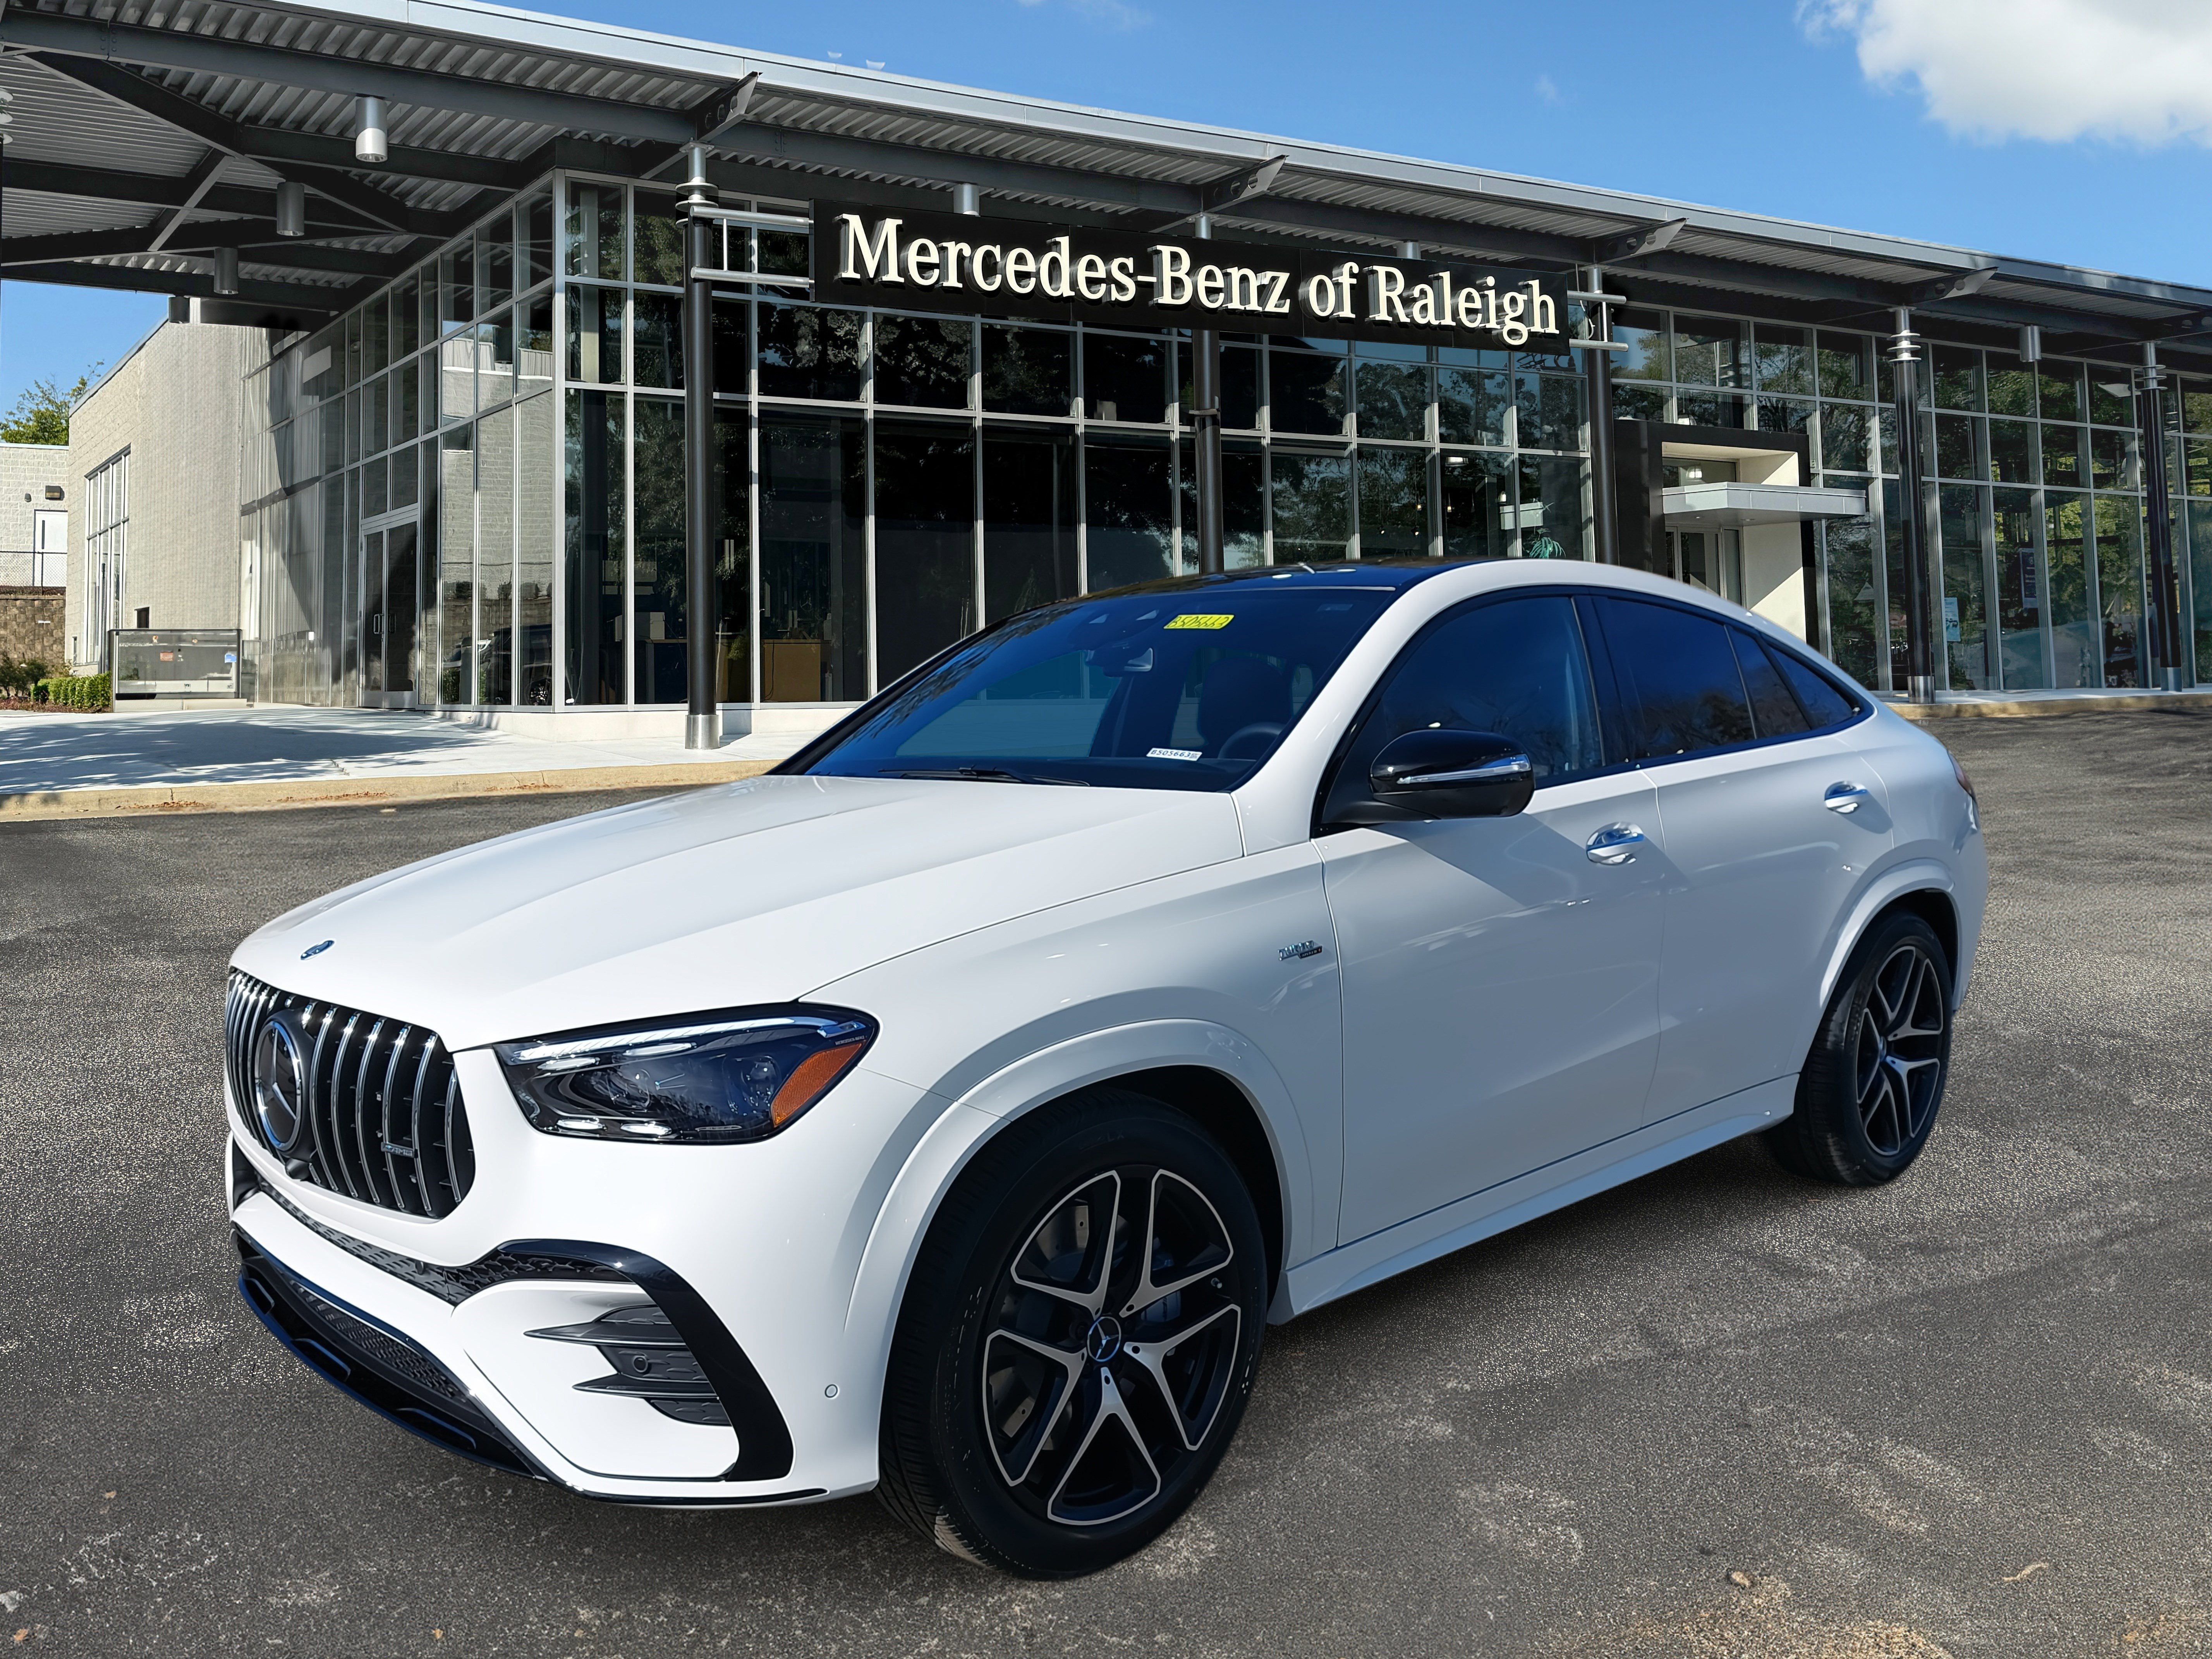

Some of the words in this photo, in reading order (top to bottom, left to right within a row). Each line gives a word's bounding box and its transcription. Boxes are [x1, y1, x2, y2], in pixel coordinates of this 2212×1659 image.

[840, 213, 1290, 314] Mercedes-Benz
[1309, 261, 1358, 319] of
[1371, 265, 1560, 345] Raleigh
[1151, 749, 1192, 758] B505663
